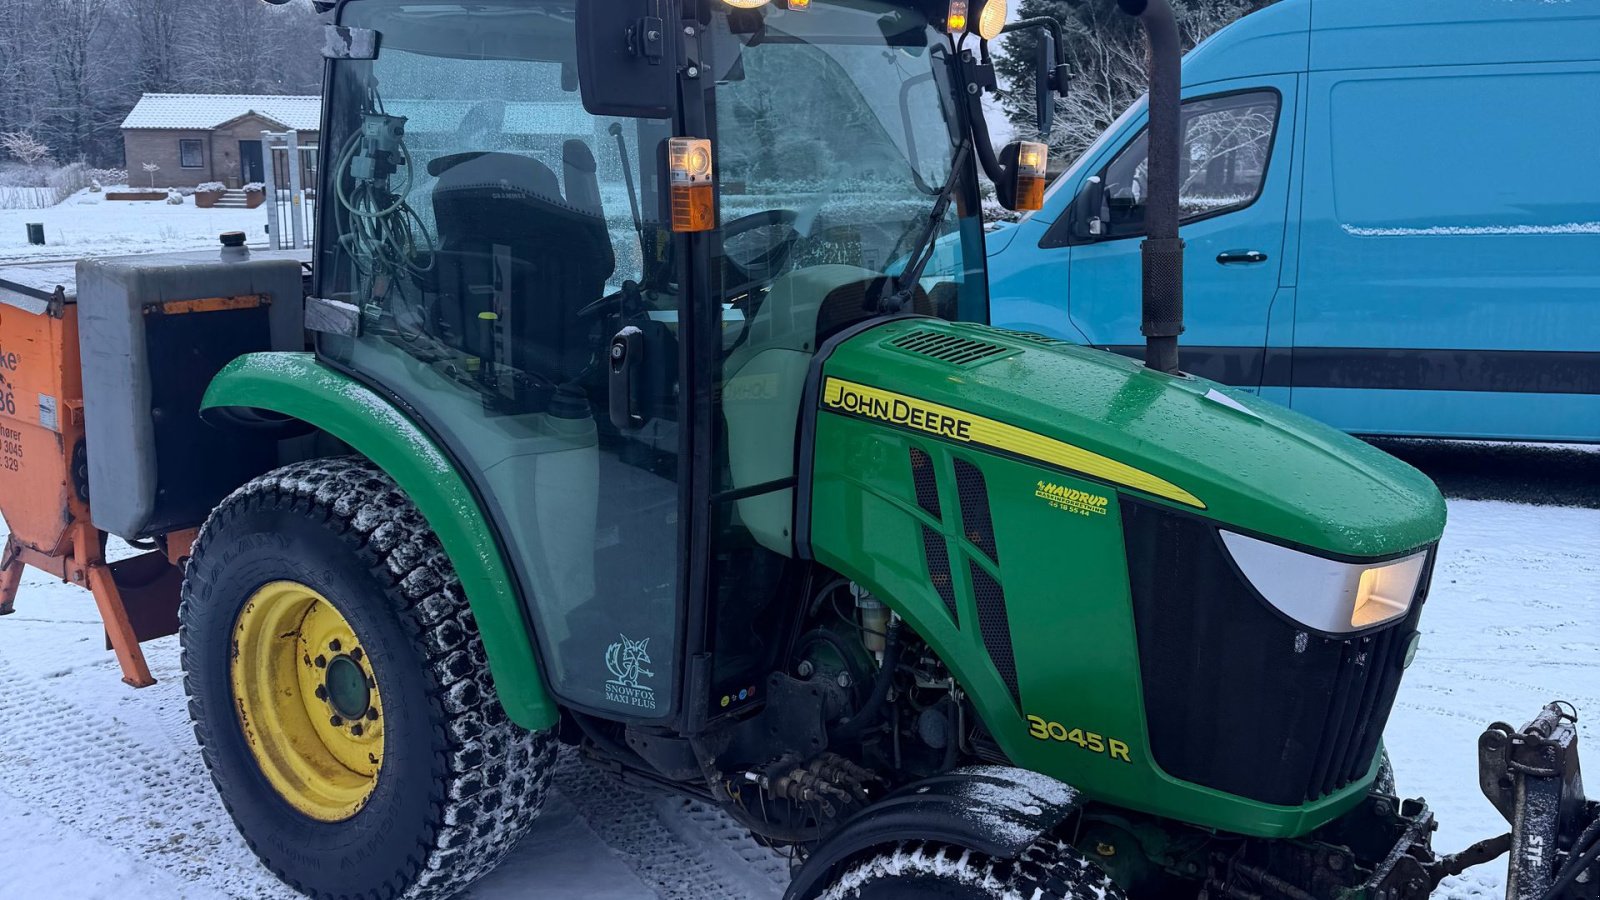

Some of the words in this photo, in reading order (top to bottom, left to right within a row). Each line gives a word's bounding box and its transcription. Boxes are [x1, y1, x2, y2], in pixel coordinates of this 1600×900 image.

[831, 386, 889, 418] JOHN
[892, 399, 972, 440] DEERE
[3, 440, 23, 458] 3045
[1044, 482, 1108, 507] HAVDRUP
[605, 683, 655, 701] SNOWFOX
[605, 692, 629, 704] MAXI
[631, 697, 656, 710] PLUS
[1027, 714, 1105, 753] 3045
[1108, 738, 1131, 763] R
